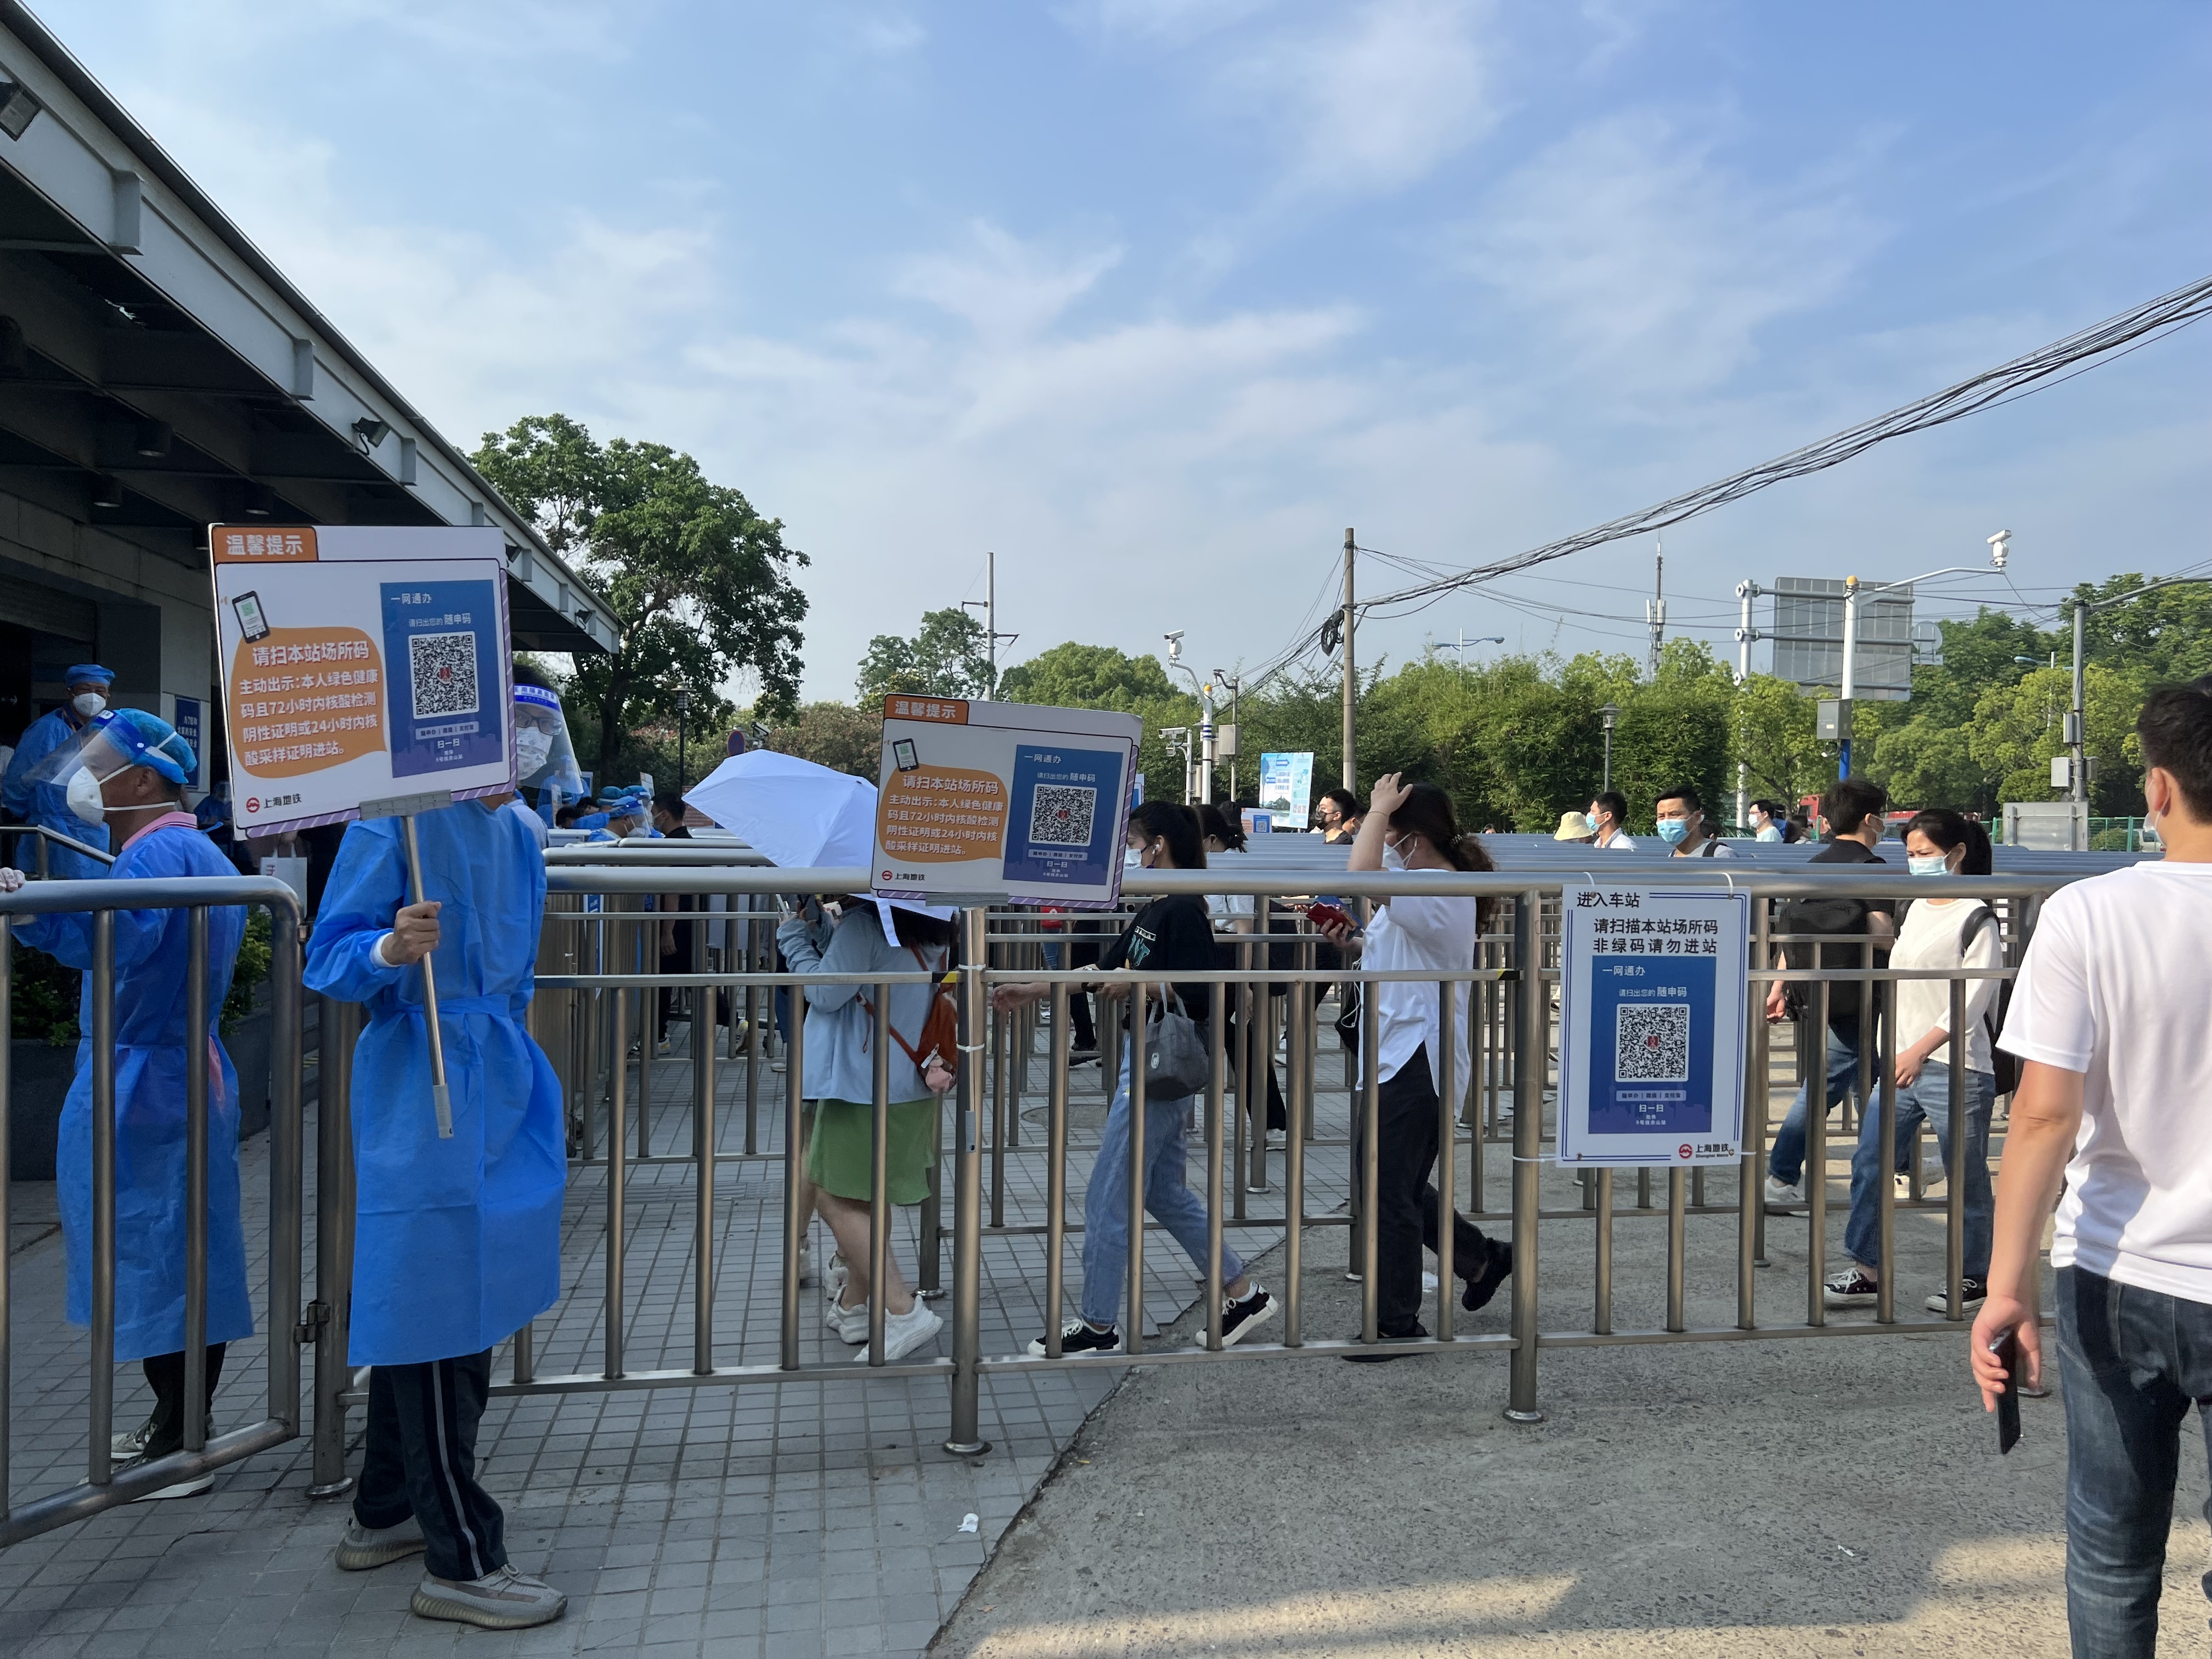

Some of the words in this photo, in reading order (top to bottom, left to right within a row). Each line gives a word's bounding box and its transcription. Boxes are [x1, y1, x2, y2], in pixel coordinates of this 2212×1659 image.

[226, 534, 303, 555] 温馨提示
[391, 592, 432, 604] 一网通办
[444, 613, 471, 625] 随申码
[252, 640, 370, 667] 请扫本站场所码
[240, 691, 376, 719] 码且72小时内核酸检测
[895, 701, 956, 719] 温馨提示
[243, 714, 378, 743] 阴性证明或24小时内核
[437, 738, 460, 749] 扫一扫
[245, 740, 345, 766] 酸采样证明进站。
[1024, 754, 1062, 764] 一网通办
[903, 775, 998, 795] 请扫本站场所码
[1070, 772, 1096, 783] 随申码
[263, 793, 302, 809] 上海地铁
[887, 809, 1000, 827] 码且72小时内核酸检测
[887, 825, 998, 842] 阴性证明或24小时内核
[885, 840, 967, 856] 酸采样证明进站。
[894, 872, 926, 881] 上海地铁
[1577, 891, 1640, 908] 进入车站
[1593, 918, 1718, 935] 请扫描本站场所码
[1593, 937, 1717, 953] 非绿码请勿进站
[1602, 965, 1645, 976] 一网通办
[1618, 989, 1656, 997] 请扫出您的
[1657, 986, 1687, 997] 随申码
[1639, 1103, 1663, 1113] 扫一扫
[1695, 1143, 1729, 1153] 上海地铁
